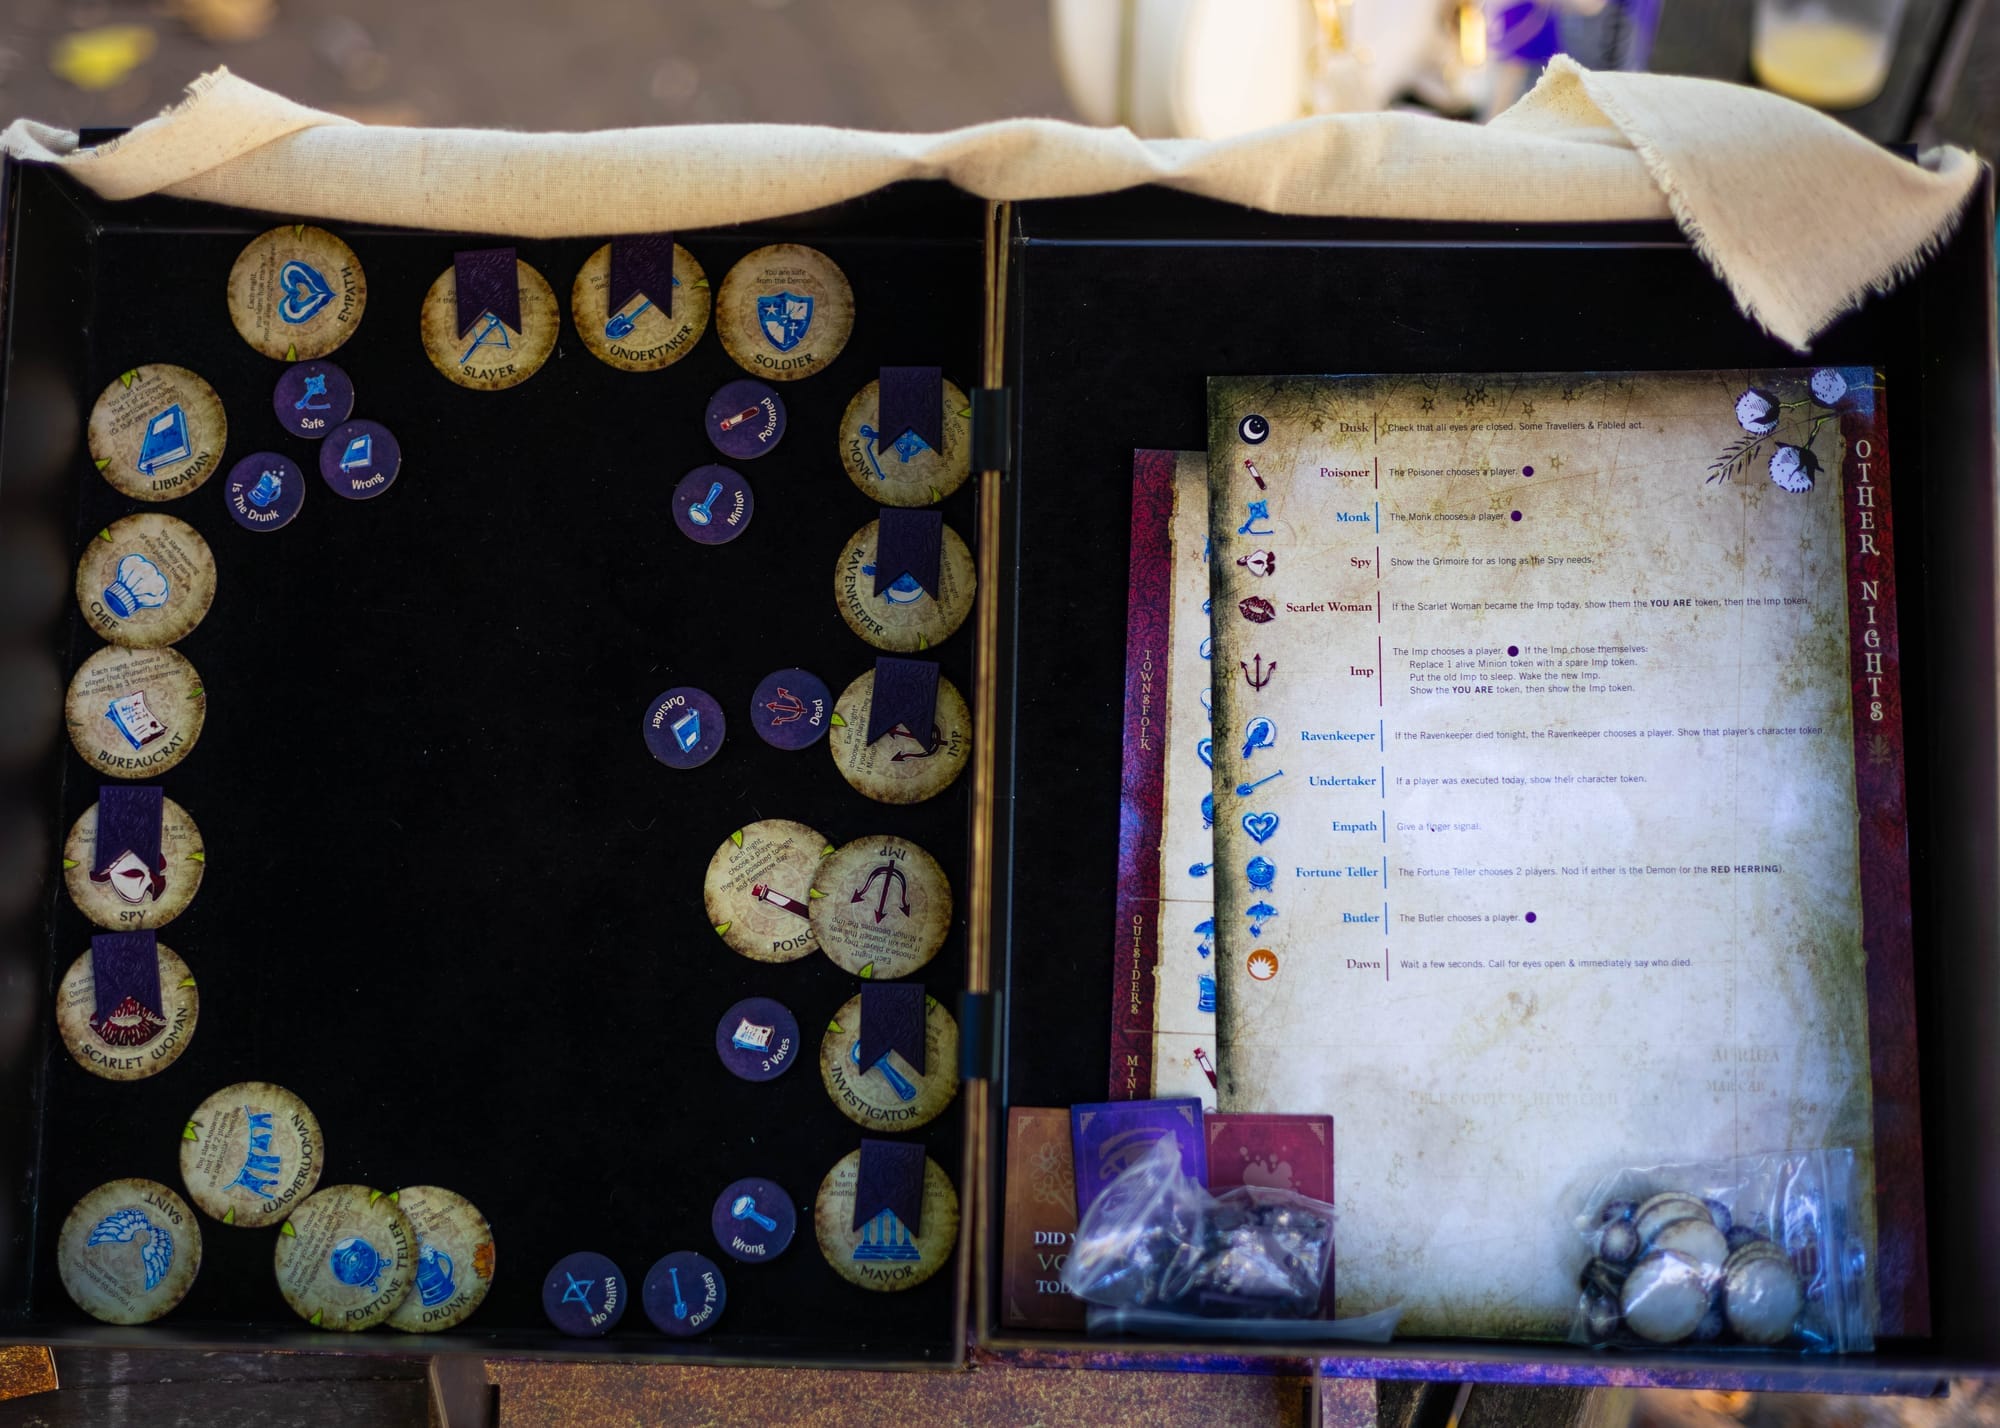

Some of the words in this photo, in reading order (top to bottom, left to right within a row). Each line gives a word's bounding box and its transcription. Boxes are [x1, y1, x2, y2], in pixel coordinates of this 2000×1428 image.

[338, 266, 356, 322] EMPATH
[609, 323, 694, 362] UNDERTAKER
[754, 352, 815, 370] SOLDIER
[462, 363, 517, 381] SLAYER
[300, 418, 325, 430] Safe
[758, 397, 776, 442] Poisoned
[1340, 422, 1369, 432] Dusk
[1388, 423, 1414, 432] Check
[1416, 423, 1434, 432] that
[1436, 422, 1447, 431] all
[1449, 424, 1468, 433] eyes
[1519, 421, 1543, 430] Some
[1546, 421, 1585, 430] Travellers
[1597, 420, 1626, 429] Fabled
[849, 440, 873, 480] MONK
[152, 451, 210, 492] LIBRARIAN
[1320, 466, 1370, 477] Poisoner
[1389, 467, 1405, 476] The
[1407, 467, 1444, 476] Poisoner
[1446, 467, 1480, 476] chooses
[232, 482, 243, 493] Is
[351, 472, 385, 490] Wrong
[233, 495, 247, 514] The
[1855, 440, 1880, 556] OTHER
[248, 509, 279, 522] Drunk
[727, 490, 744, 526] Minion
[1336, 512, 1371, 522] Monk
[1350, 556, 1372, 569] Spy
[1390, 557, 1414, 566] Show
[1416, 557, 1430, 566] the
[1432, 556, 1469, 565] Grimoire
[1472, 556, 1483, 565] for
[1498, 556, 1517, 567] long
[1529, 556, 1545, 565] the
[1547, 555, 1564, 566] Spy
[845, 548, 883, 636] RAVENKEEPER
[1286, 602, 1324, 612] Scarlet
[1328, 601, 1373, 612] Woman
[1401, 602, 1415, 611] the
[1417, 601, 1448, 610] Scarlet
[1450, 601, 1482, 610] Woman
[1484, 600, 1518, 609] became
[1520, 600, 1534, 609] the
[1537, 600, 1554, 611] Imp
[1584, 599, 1606, 608] show
[1608, 599, 1631, 608] them
[1633, 598, 1648, 607] the
[1650, 598, 1670, 607] YOU
[1673, 598, 1692, 607] ARE
[1724, 597, 1744, 606] then
[1746, 597, 1761, 606] the
[1764, 597, 1780, 608] Imp
[90, 601, 119, 630] CHEF
[1393, 647, 1409, 656] The
[1412, 647, 1428, 658] Imp
[1431, 647, 1465, 656] chooses
[1534, 645, 1548, 654] the
[1550, 645, 1568, 656] Imp
[1570, 645, 1595, 654] chose
[1861, 581, 1883, 720] NIGHTS
[1350, 665, 1374, 678] Imp
[1410, 685, 1433, 694] Show
[1436, 685, 1450, 694] the
[1452, 685, 1471, 694] YOU
[1474, 685, 1494, 694] ARE
[1526, 684, 1545, 693] then
[1548, 684, 1569, 693] show
[1572, 684, 1586, 693] the
[1589, 683, 1606, 694] Imp
[1140, 650, 1155, 750] TOWNSFOLK
[652, 696, 685, 728] Outsider
[810, 699, 823, 726] Dead
[946, 731, 962, 757] IMP
[1301, 730, 1376, 743] Ravenkeeper
[98, 732, 184, 769] BUREAUCRAT
[1309, 775, 1376, 785] Undertaker
[1332, 821, 1377, 833] Empath
[729, 849, 746, 864] Each
[880, 846, 905, 860] IMP
[728, 858, 749, 876] choose
[1296, 867, 1342, 877] Fortune
[1348, 866, 1379, 877] Teller
[120, 910, 146, 922] SPY
[1343, 912, 1380, 922] Butler
[773, 928, 816, 952] POISO
[1130, 914, 1141, 1014] OUTSIDERS
[1346, 958, 1380, 968] Dawn
[1400, 959, 1419, 968] Wait
[1430, 959, 1445, 968] few
[1488, 958, 1505, 967] Call
[1508, 958, 1520, 967] for
[1522, 960, 1542, 969] eyes
[1544, 960, 1566, 969] open
[1578, 958, 1632, 969] immediately
[1634, 959, 1649, 968] say
[1651, 957, 1669, 966] who
[82, 1044, 144, 1070] SCARLET
[152, 1007, 188, 1060] WOMAN
[762, 1060, 770, 1071] 3
[770, 1038, 790, 1065] Votes
[1126, 1056, 1138, 1099] MINI
[832, 1066, 918, 1122] INVESTIGATOR
[263, 1114, 313, 1214] WASHERWOMAN
[145, 1193, 183, 1226] SAINT
[731, 1236, 766, 1256] Wrong
[1033, 1231, 1066, 1245] DID
[346, 1278, 401, 1322] FORTUNE
[389, 1220, 409, 1268] TELLER
[860, 1265, 914, 1282] MAYOR
[701, 1272, 717, 1302] Today
[1035, 1279, 1073, 1294] TOD
[422, 1293, 471, 1323] DRUNK
[591, 1312, 607, 1327] No
[604, 1276, 617, 1312] Ability
[690, 1306, 714, 1327] Died
